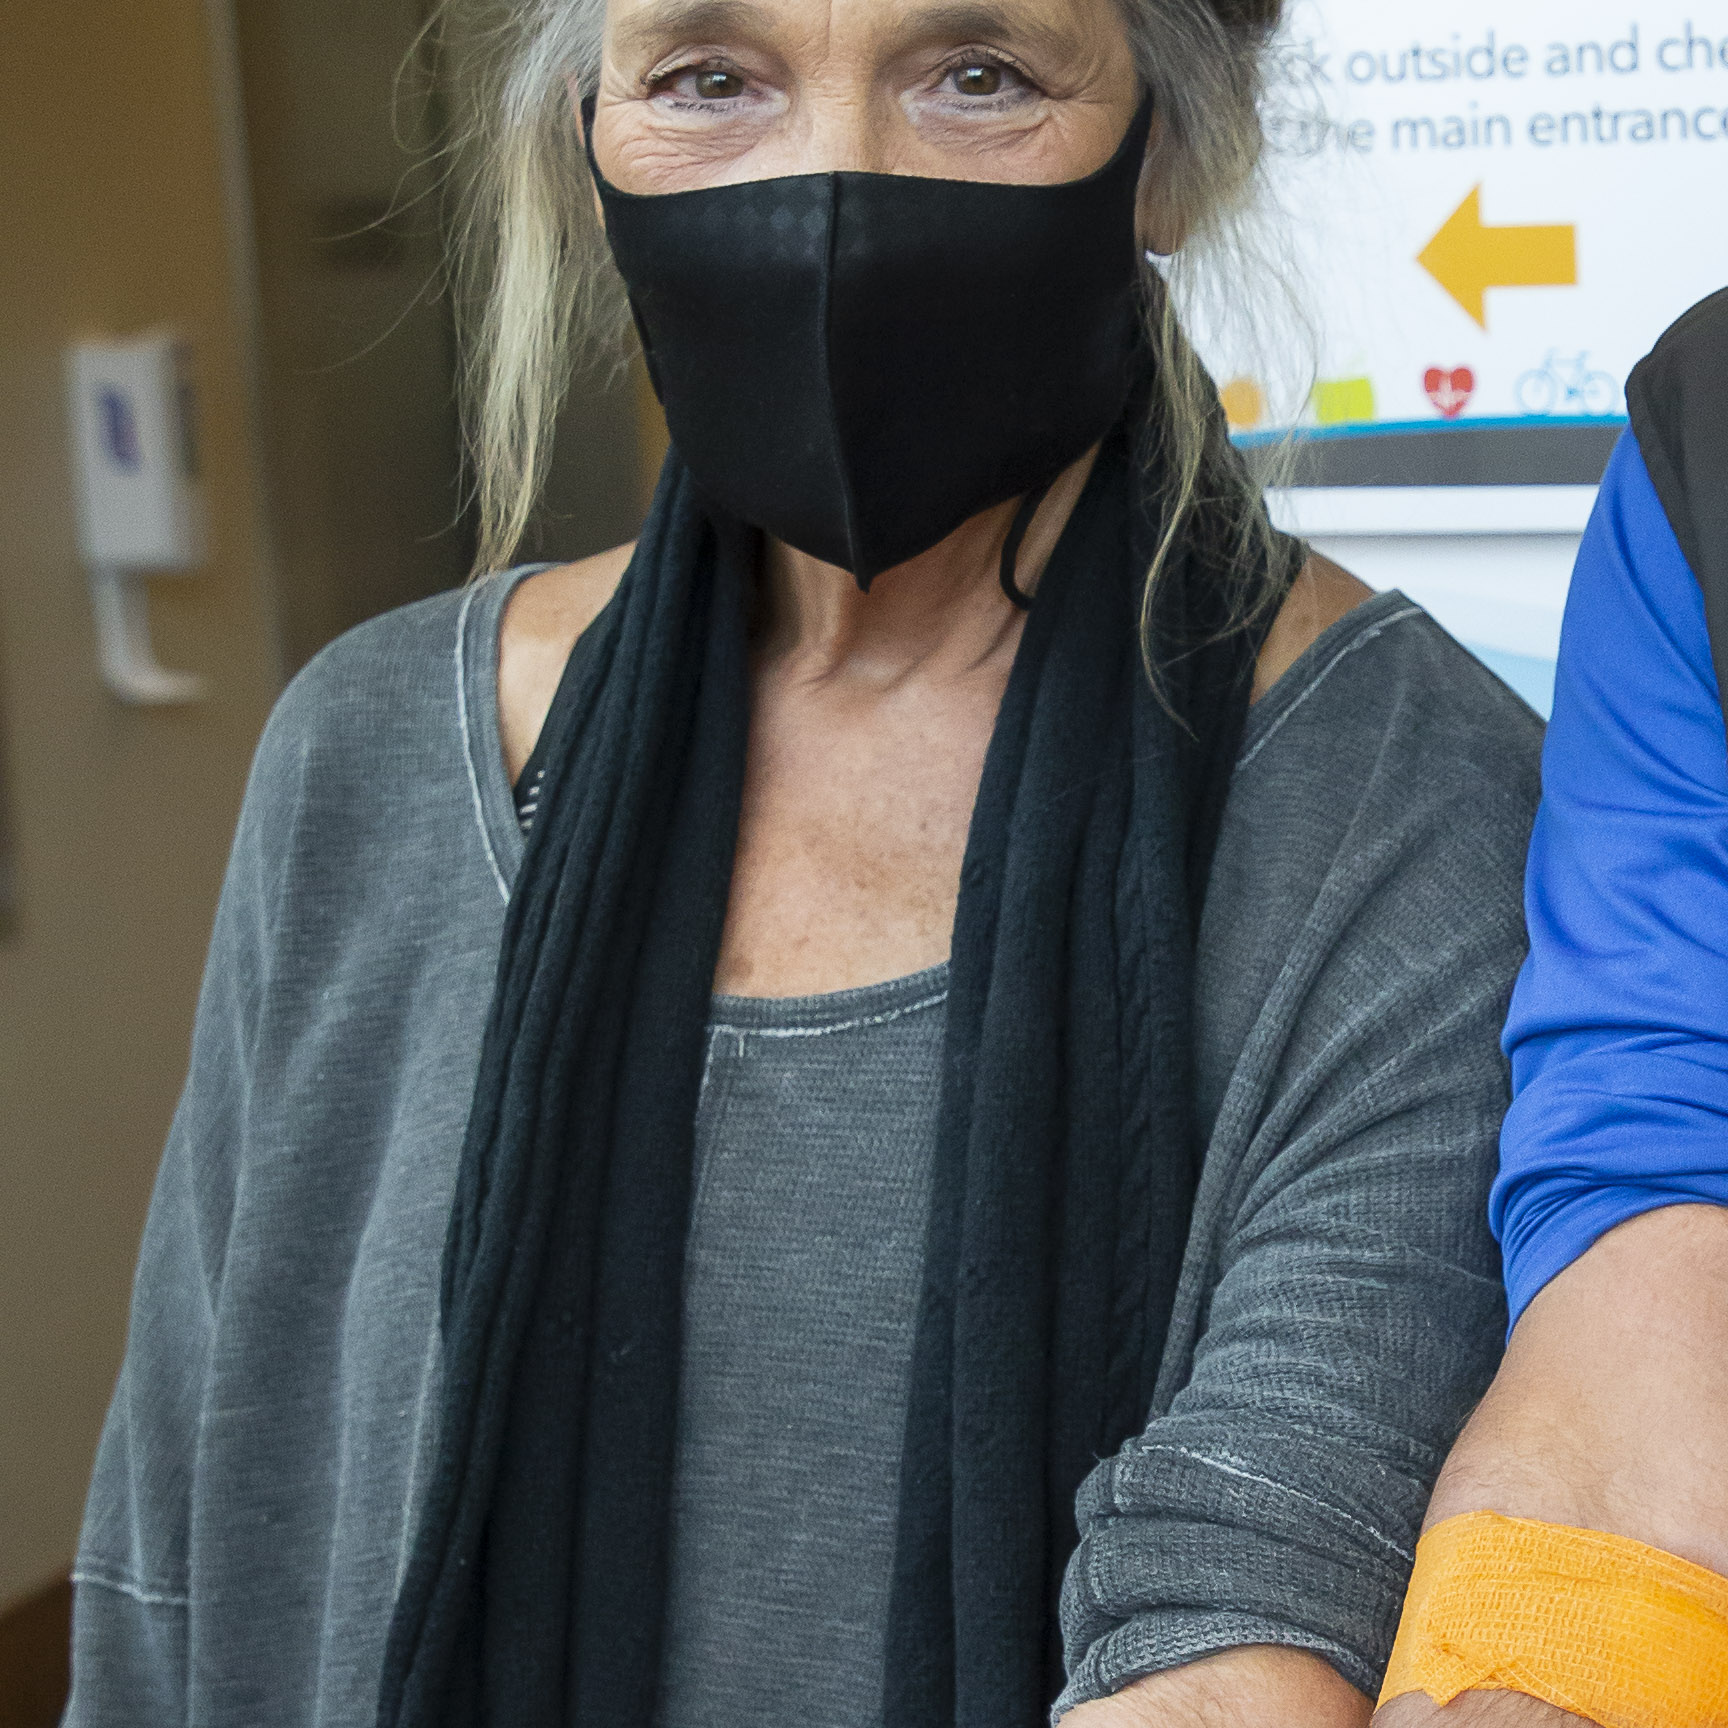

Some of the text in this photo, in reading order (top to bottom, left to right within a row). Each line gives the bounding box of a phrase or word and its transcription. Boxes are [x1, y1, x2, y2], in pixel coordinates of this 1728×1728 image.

[1346, 29, 1529, 84] outside
[1545, 21, 1639, 76] and
[1392, 99, 1512, 150] main
